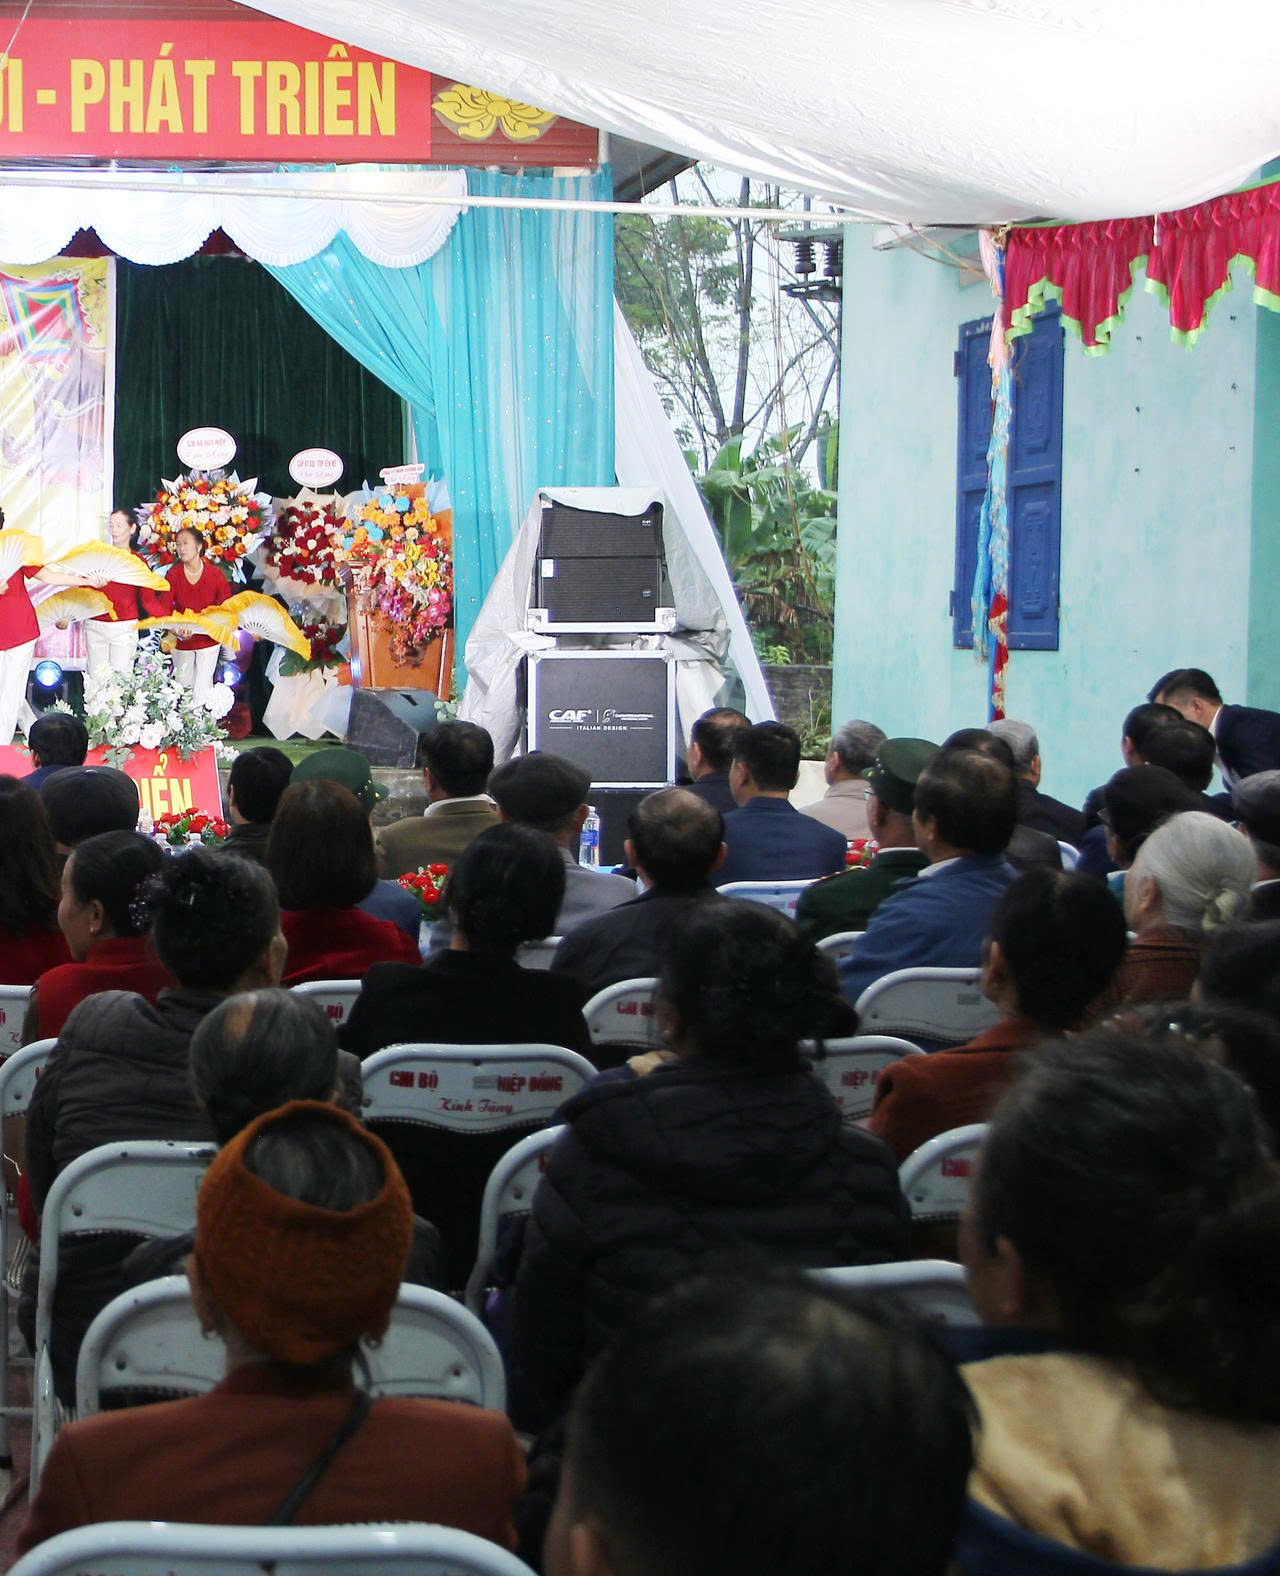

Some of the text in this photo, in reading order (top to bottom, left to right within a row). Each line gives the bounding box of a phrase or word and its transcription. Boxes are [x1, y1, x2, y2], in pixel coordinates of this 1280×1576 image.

[71, 42, 215, 134] PHÁT
[548, 709, 592, 721] CAF
[418, 1070, 438, 1092] BỘ
